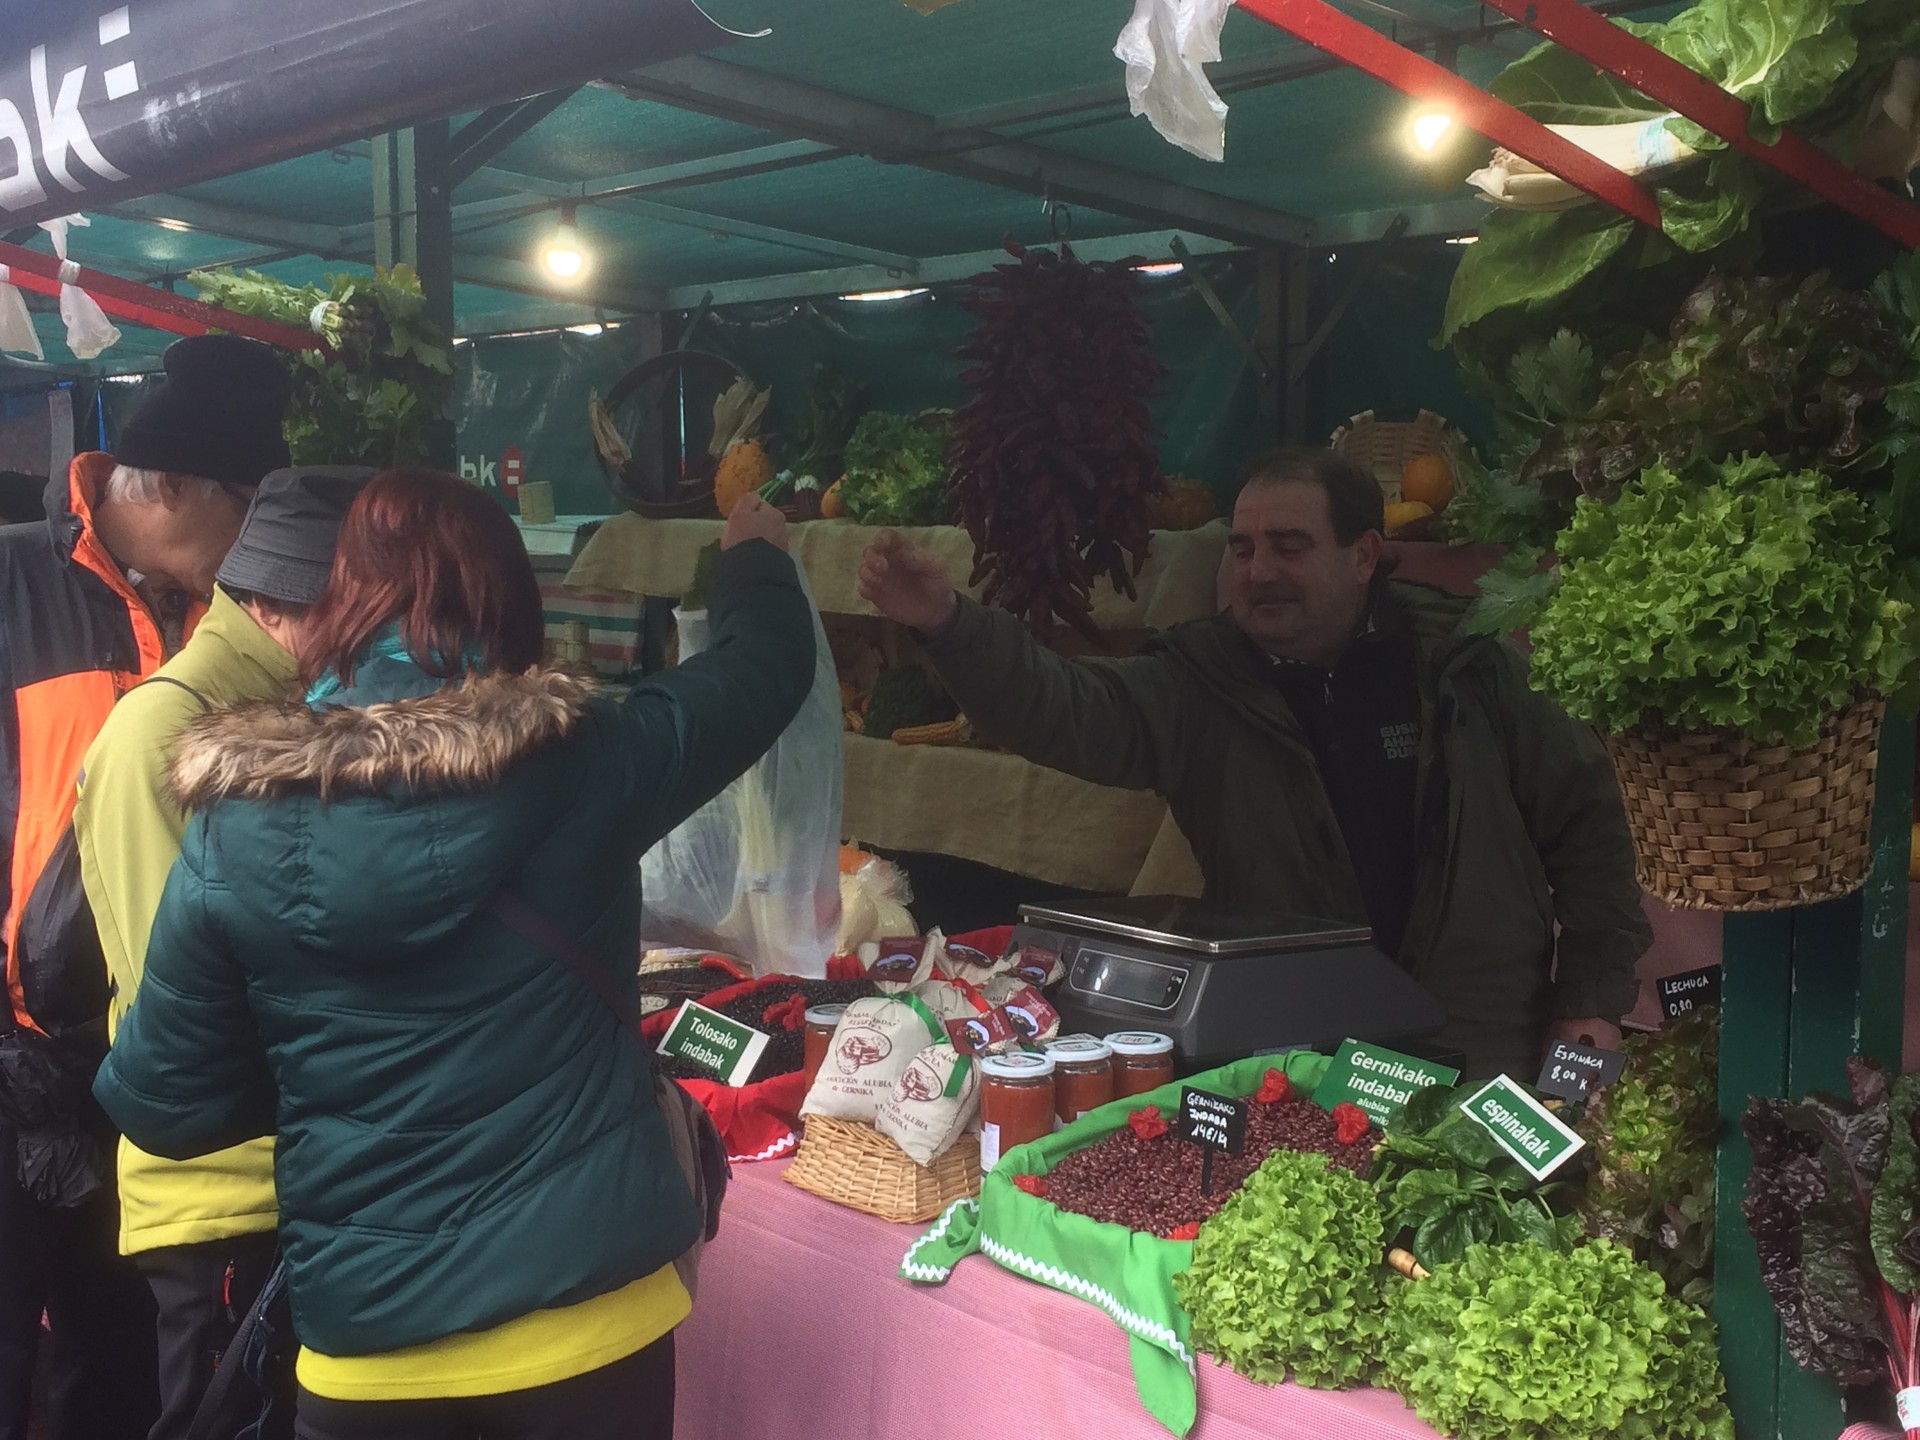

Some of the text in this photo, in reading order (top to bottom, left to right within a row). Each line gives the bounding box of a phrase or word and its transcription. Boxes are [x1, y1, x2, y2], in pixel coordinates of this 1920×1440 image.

[689, 1016, 738, 1050] Tolosako
[679, 1037, 725, 1070] indabak
[1350, 1051, 1437, 1087] Gernikako
[1554, 1044, 1604, 1070] ESPINACA
[1188, 1107, 1228, 1129] INDABA
[1356, 1097, 1390, 1114] alubias
[1481, 1098, 1550, 1159] espinakak
